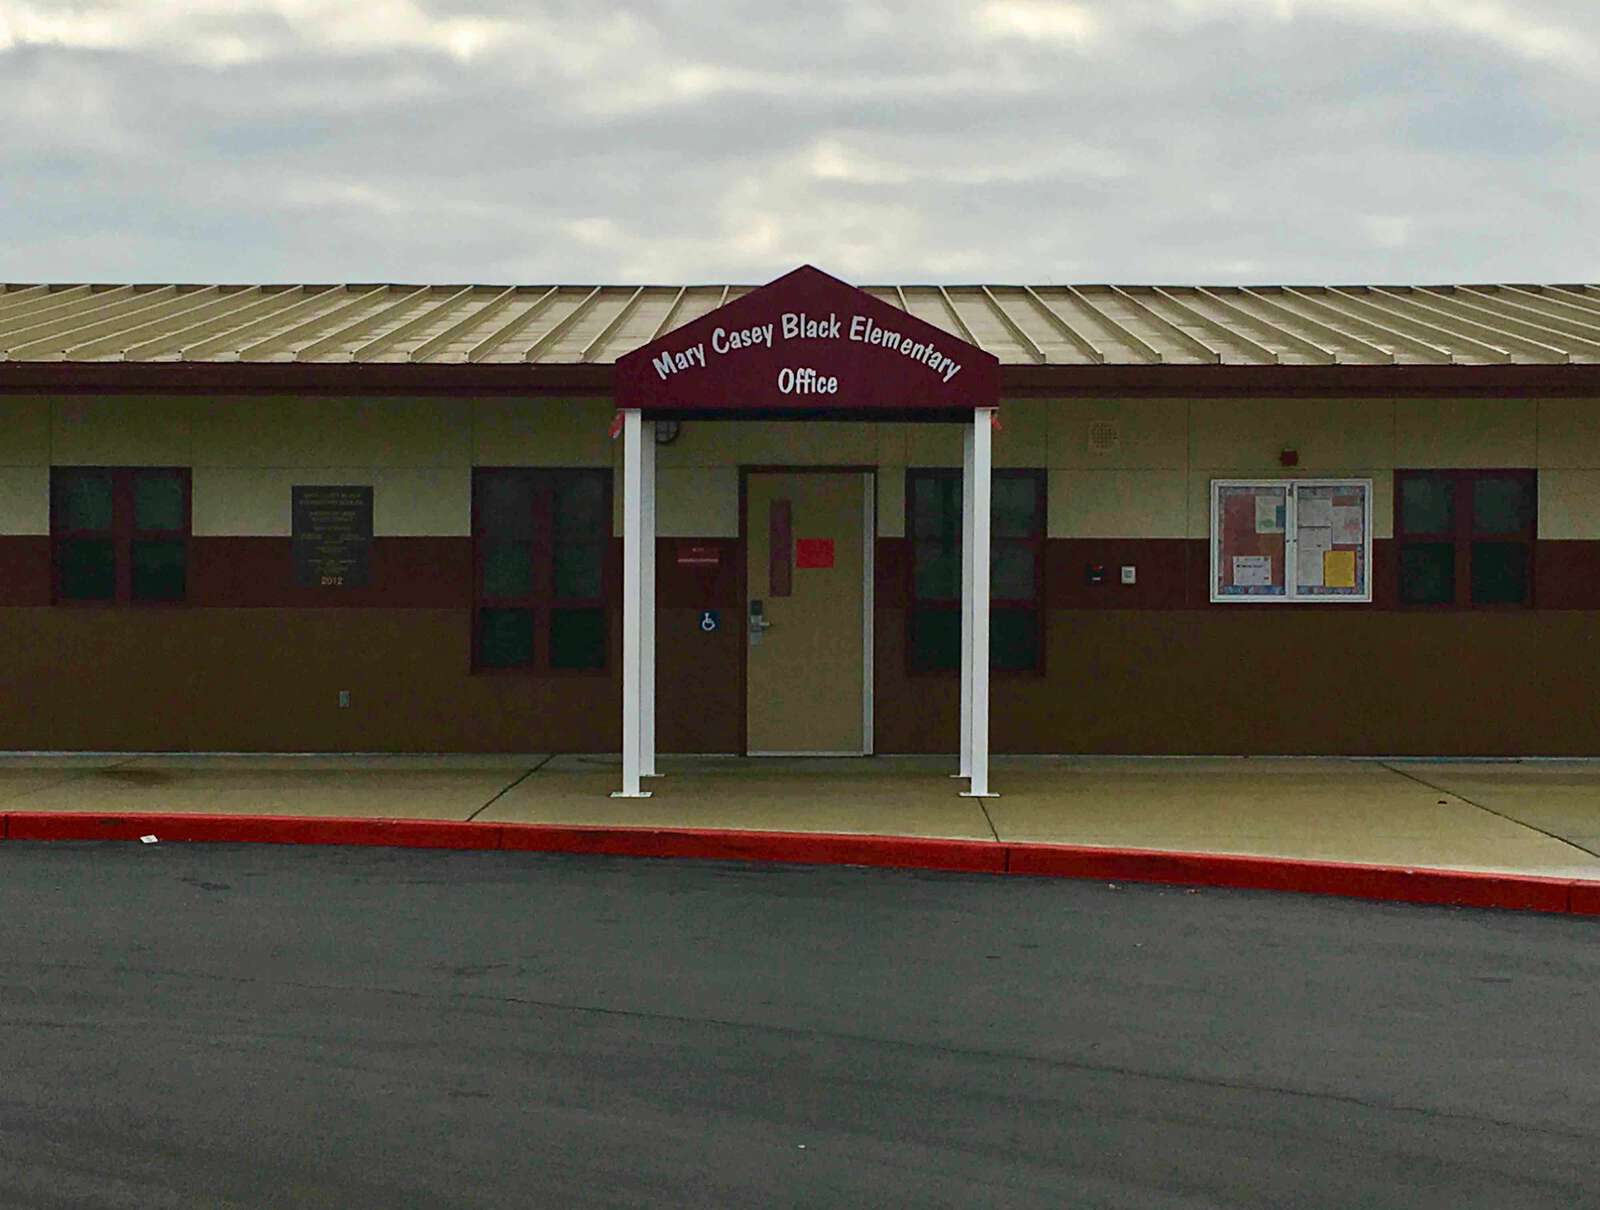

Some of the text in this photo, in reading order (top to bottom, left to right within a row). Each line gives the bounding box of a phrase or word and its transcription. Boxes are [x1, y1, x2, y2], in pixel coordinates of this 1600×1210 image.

[652, 312, 962, 383] Mary Casey Black Elementary
[777, 367, 838, 394] Office
[321, 575, 344, 585] 2012
